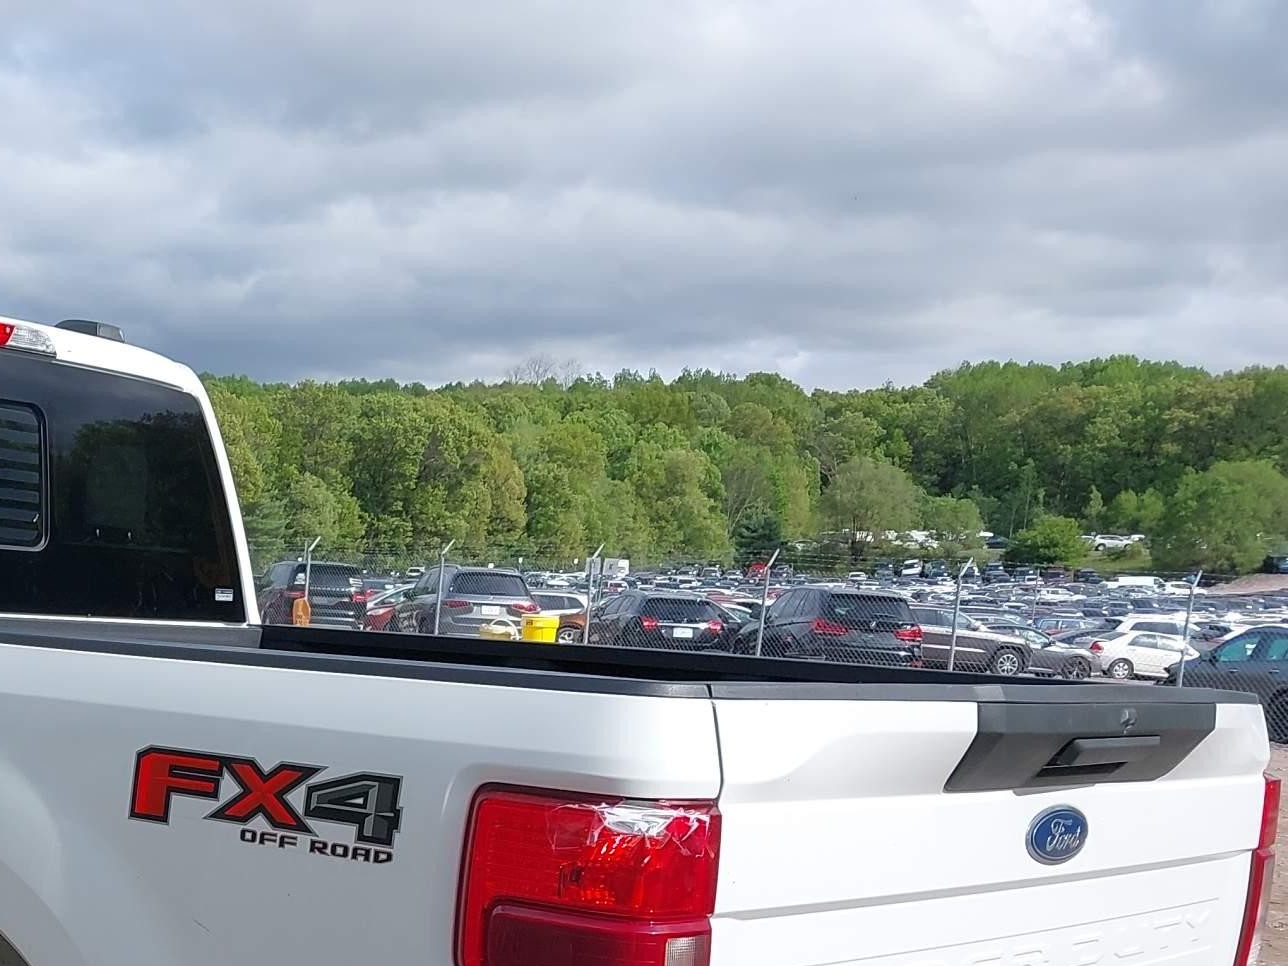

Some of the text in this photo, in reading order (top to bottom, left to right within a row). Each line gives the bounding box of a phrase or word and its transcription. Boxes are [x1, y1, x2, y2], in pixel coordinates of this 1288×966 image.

[128, 744, 404, 849] FX4
[239, 828, 394, 865] OFF ROAD
